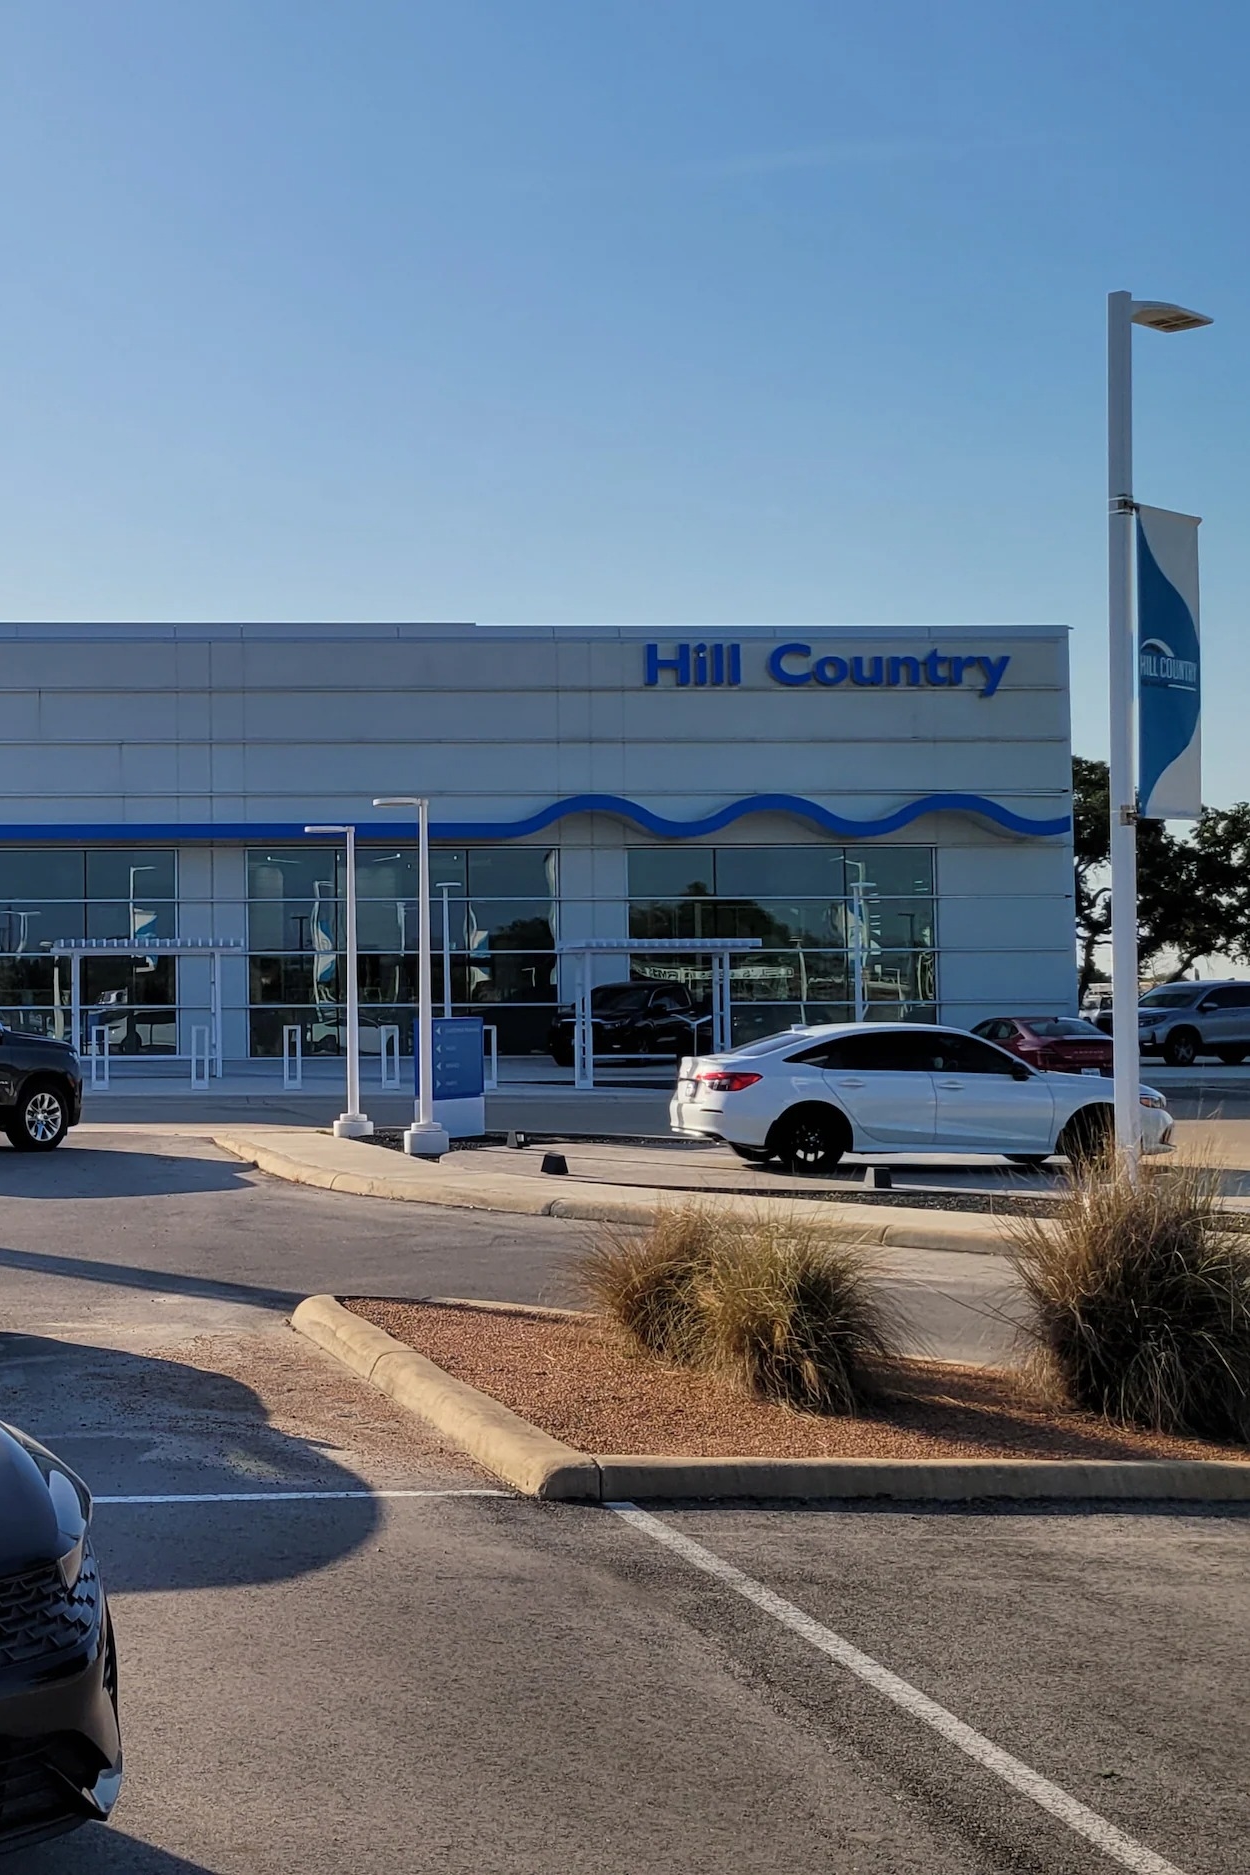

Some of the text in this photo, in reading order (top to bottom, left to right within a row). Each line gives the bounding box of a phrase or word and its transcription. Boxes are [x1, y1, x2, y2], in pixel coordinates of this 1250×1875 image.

[644, 642, 1011, 698] Hill Country
[1140, 655, 1198, 683] HILL COUNTRY
